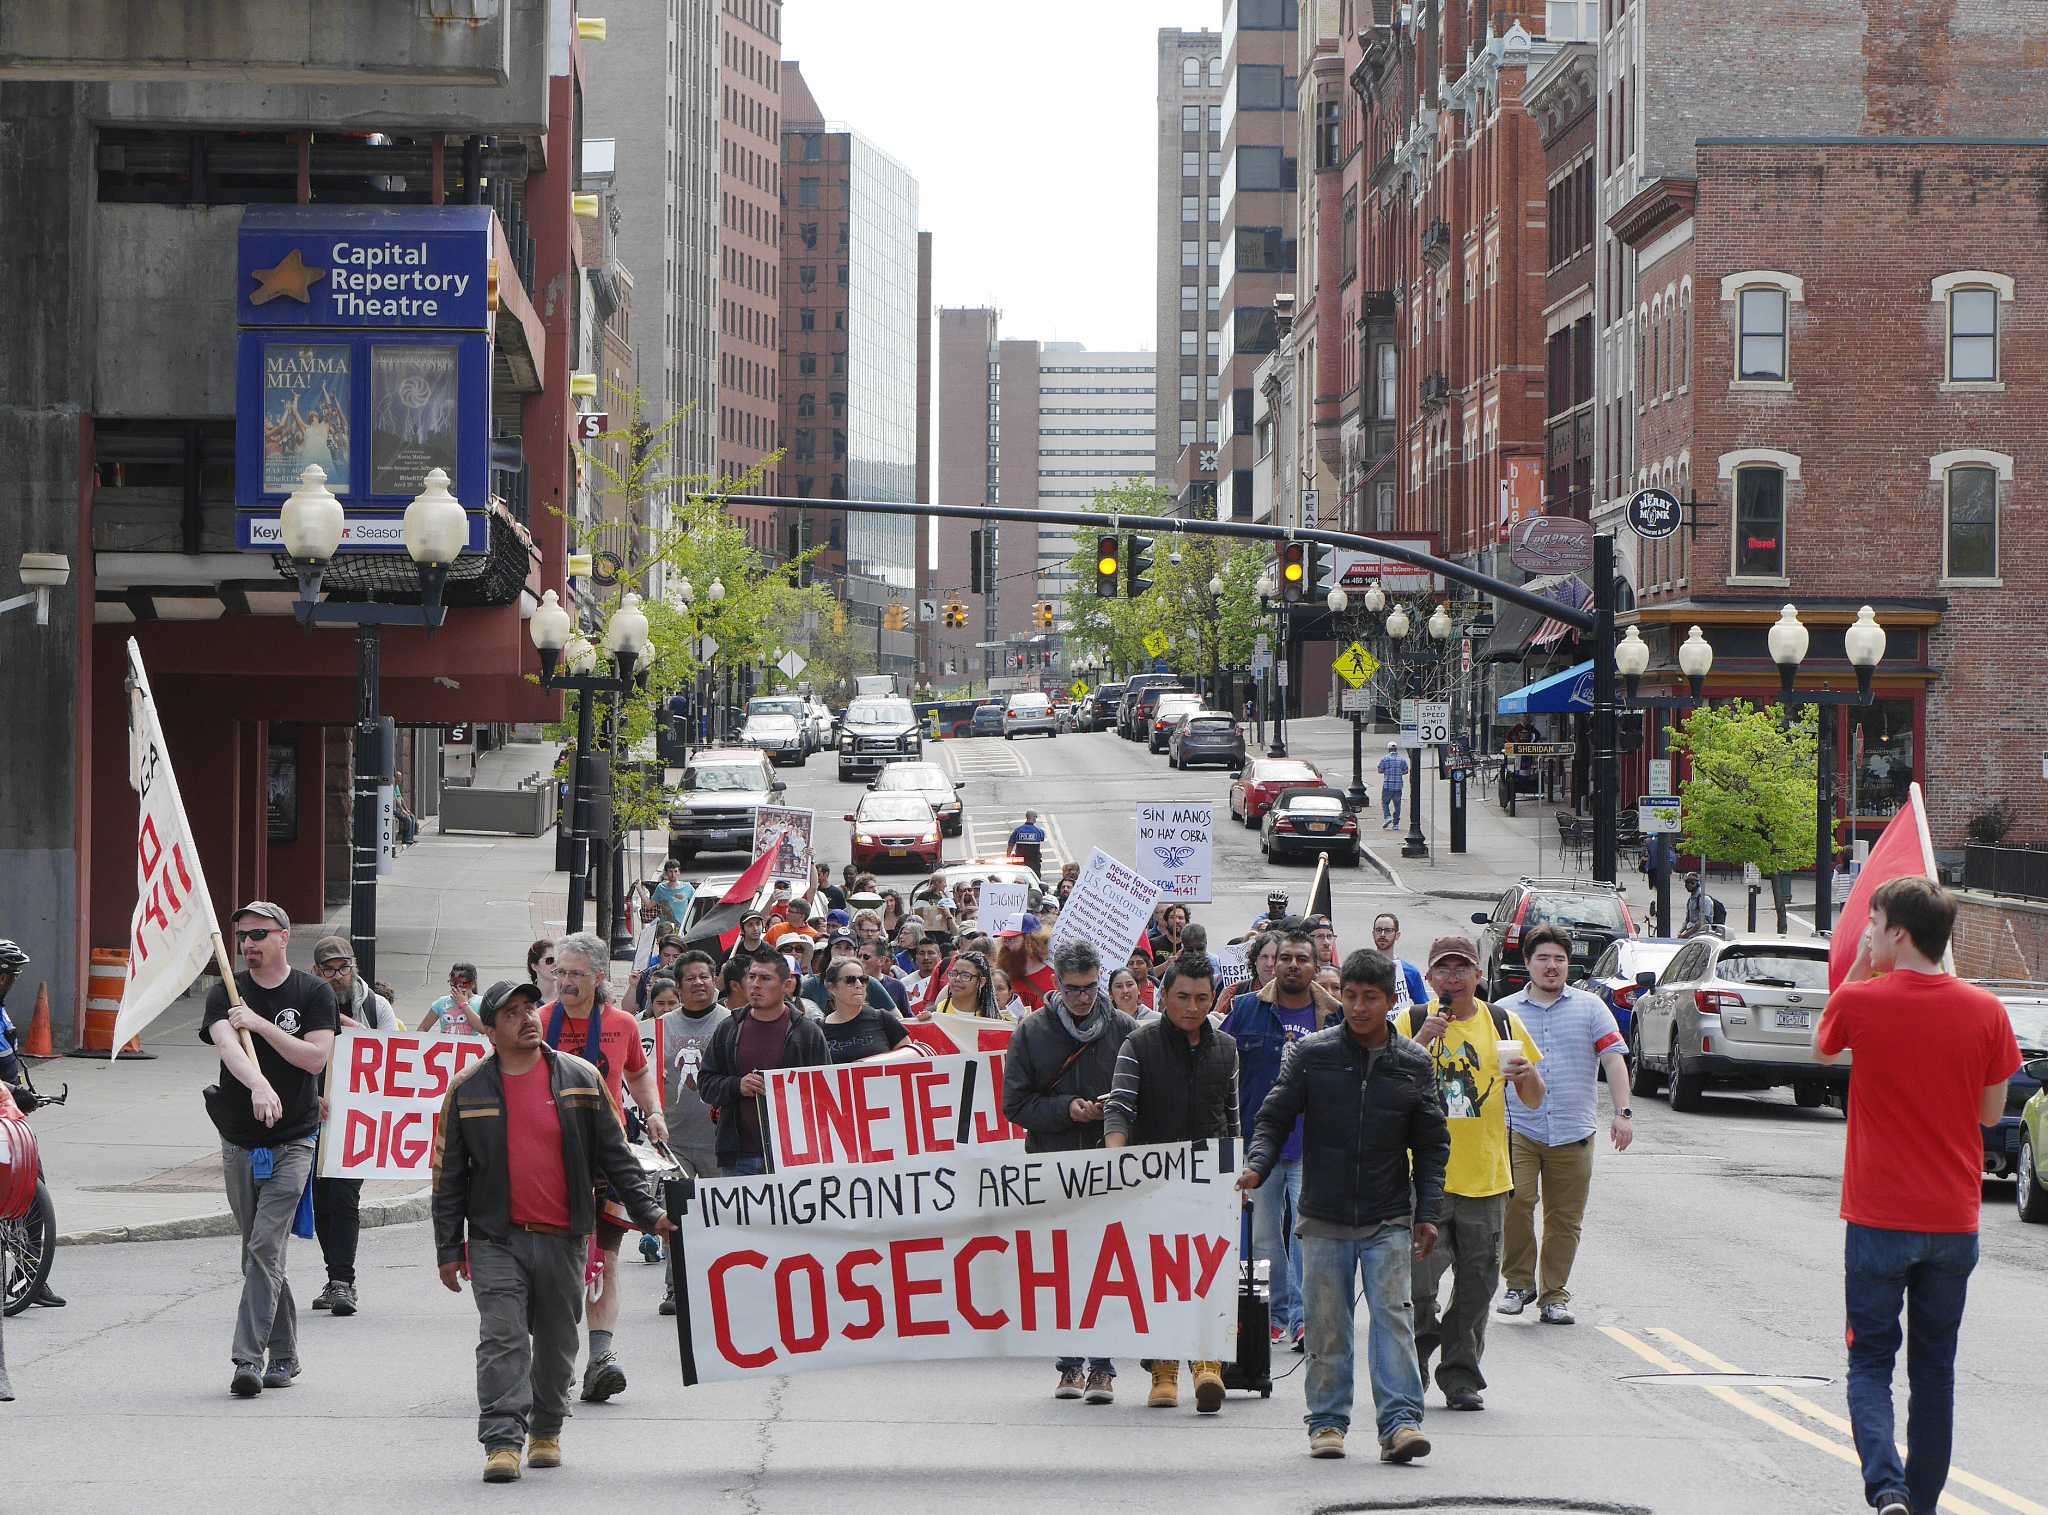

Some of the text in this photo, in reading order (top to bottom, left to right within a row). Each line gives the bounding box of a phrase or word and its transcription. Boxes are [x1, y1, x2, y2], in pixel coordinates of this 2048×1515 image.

[332, 242, 427, 270] Capital
[332, 268, 469, 297] Repertory
[332, 292, 438, 316] Theatre
[266, 358, 349, 374] MAMMA
[266, 373, 311, 388] MIA!
[1639, 497, 1672, 511] MERRY
[1640, 510, 1669, 521] MONK
[253, 525, 282, 541] Key
[1421, 726, 1447, 741] 30
[1518, 745, 1554, 753] SHERIDAN
[1143, 808, 1212, 828] SIN MANOS
[382, 804, 391, 855] STOP
[1141, 827, 1209, 844] NO HAY OBRA
[1104, 871, 1152, 905] about these
[1109, 863, 1159, 899] never forget
[1174, 875, 1202, 885] TEXT
[988, 893, 1025, 912] DIGNITY
[700, 1146, 1211, 1228] IMMIGRANTS ARE WELCOME
